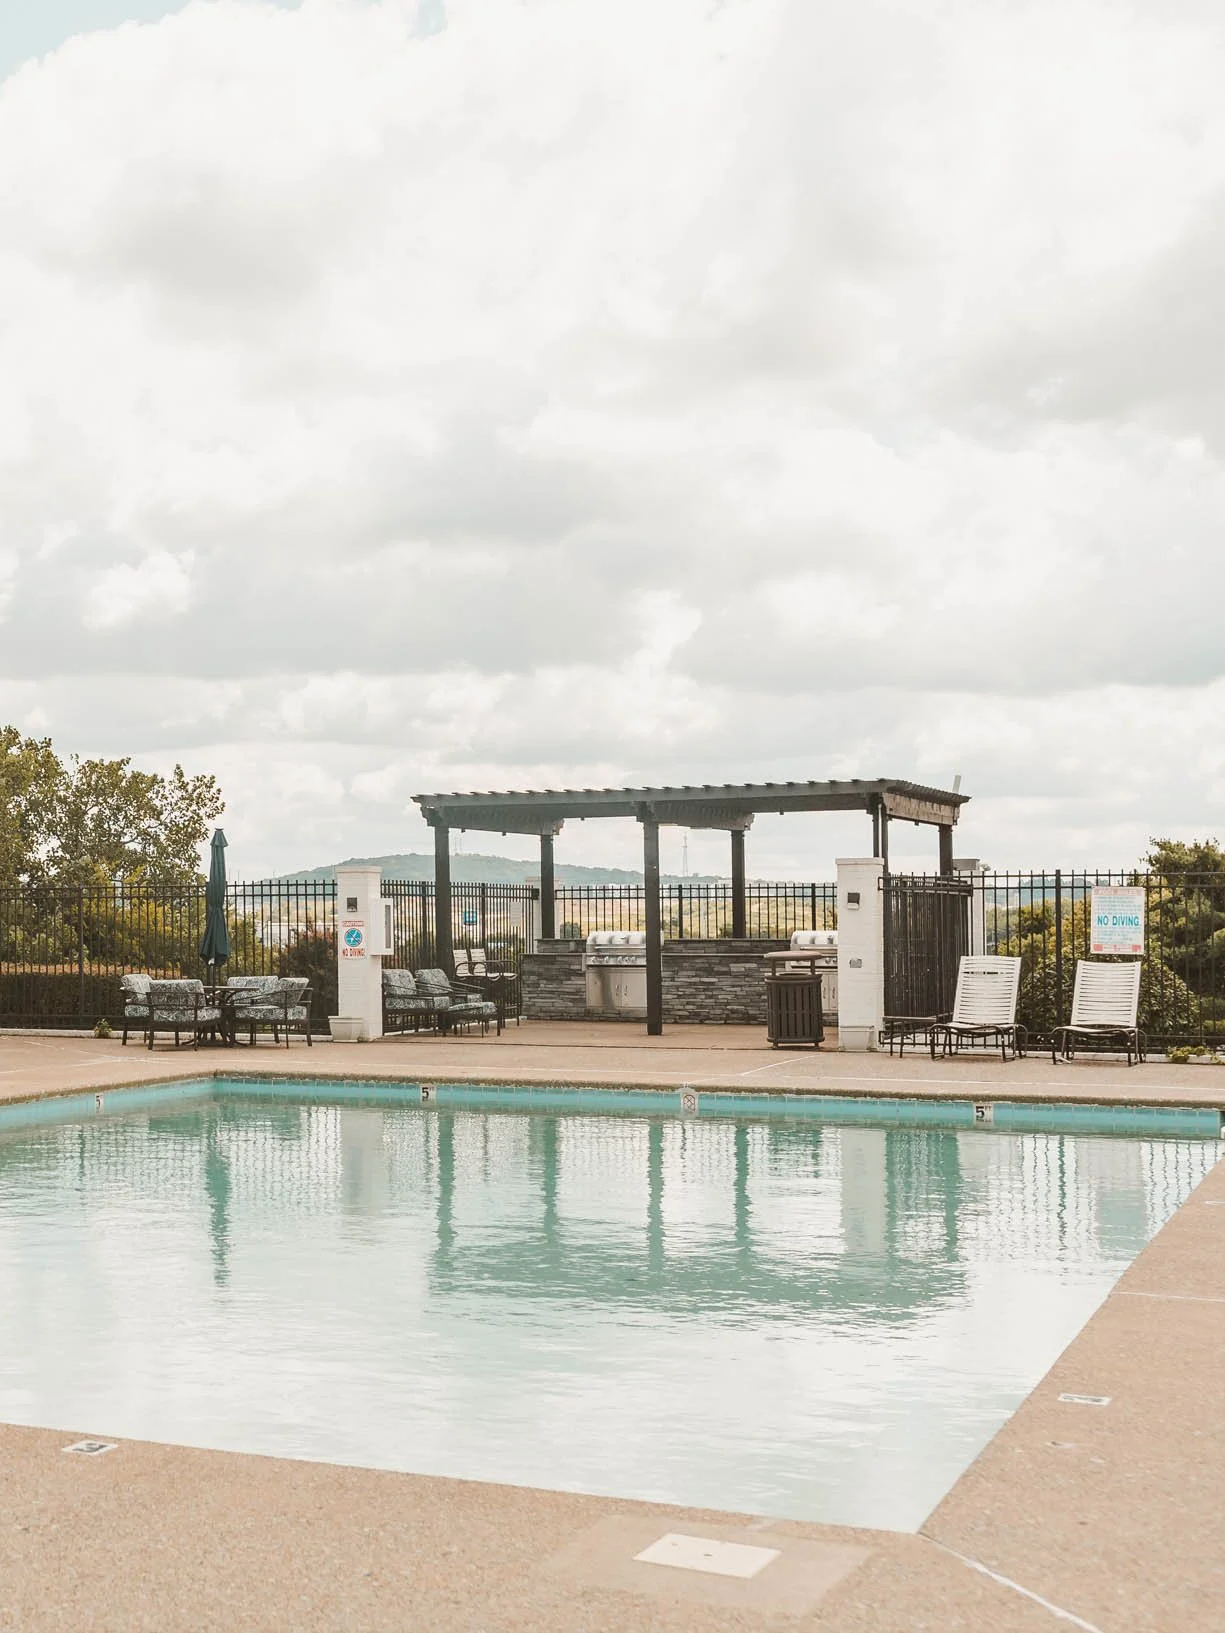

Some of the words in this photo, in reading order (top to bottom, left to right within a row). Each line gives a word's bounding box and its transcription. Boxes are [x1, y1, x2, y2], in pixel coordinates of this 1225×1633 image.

[1097, 915, 1109, 926] NO
[1112, 915, 1140, 927] DIVING
[342, 948, 349, 956] NO
[422, 1087, 429, 1098] 5
[976, 1105, 984, 1118] 5
